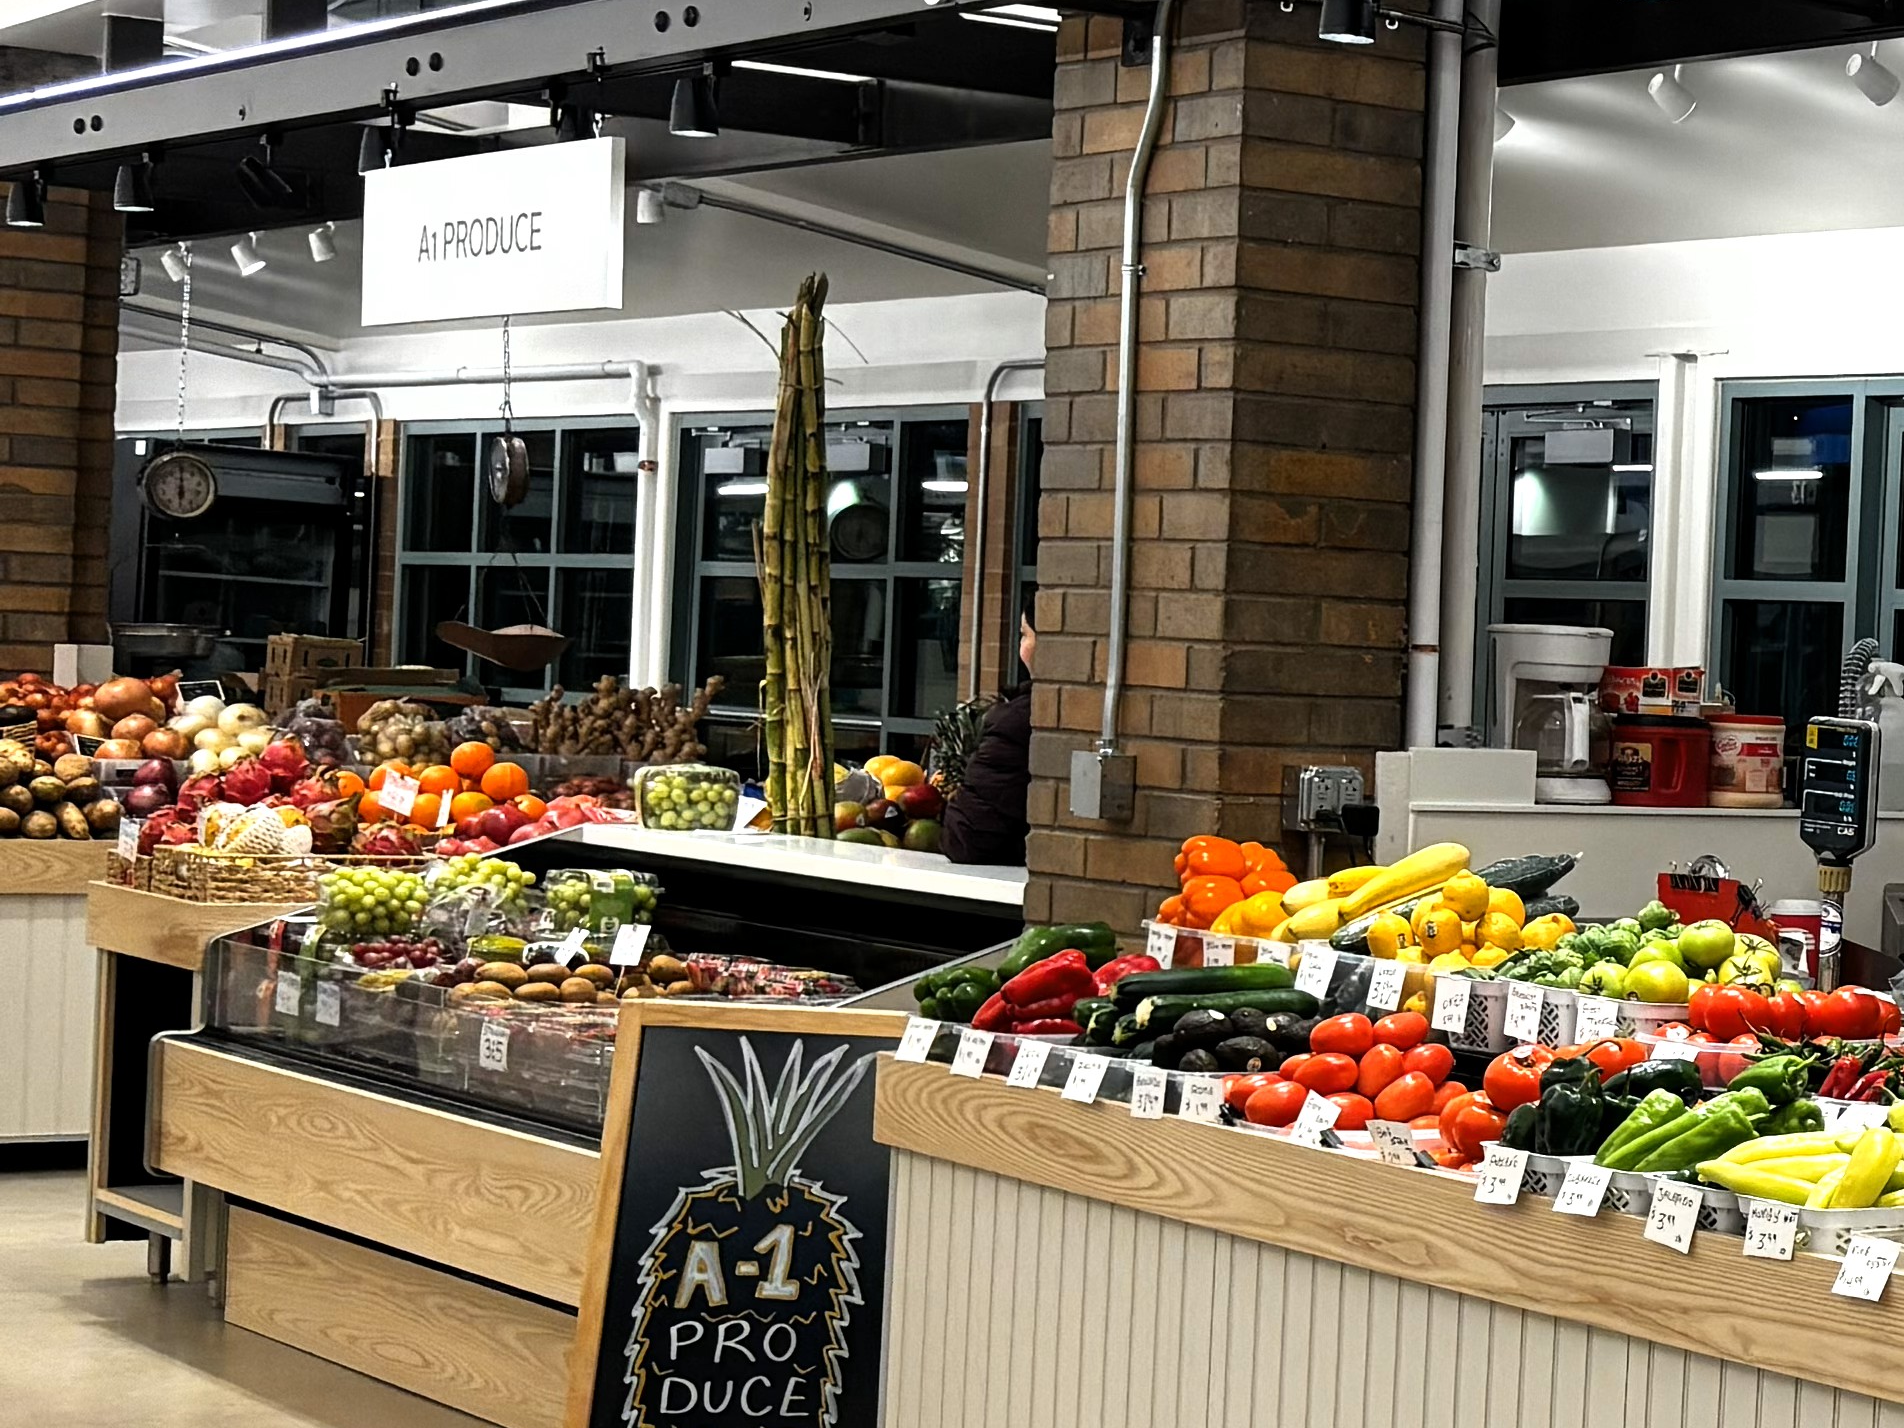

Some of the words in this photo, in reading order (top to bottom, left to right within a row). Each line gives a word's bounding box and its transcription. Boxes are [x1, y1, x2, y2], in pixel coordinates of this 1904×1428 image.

[418, 224, 437, 263] A1
[443, 211, 542, 261] PRODUCE
[1837, 826, 1855, 836] CAS
[669, 1320, 797, 1363] PRO
[658, 1375, 810, 1418] DUCE
